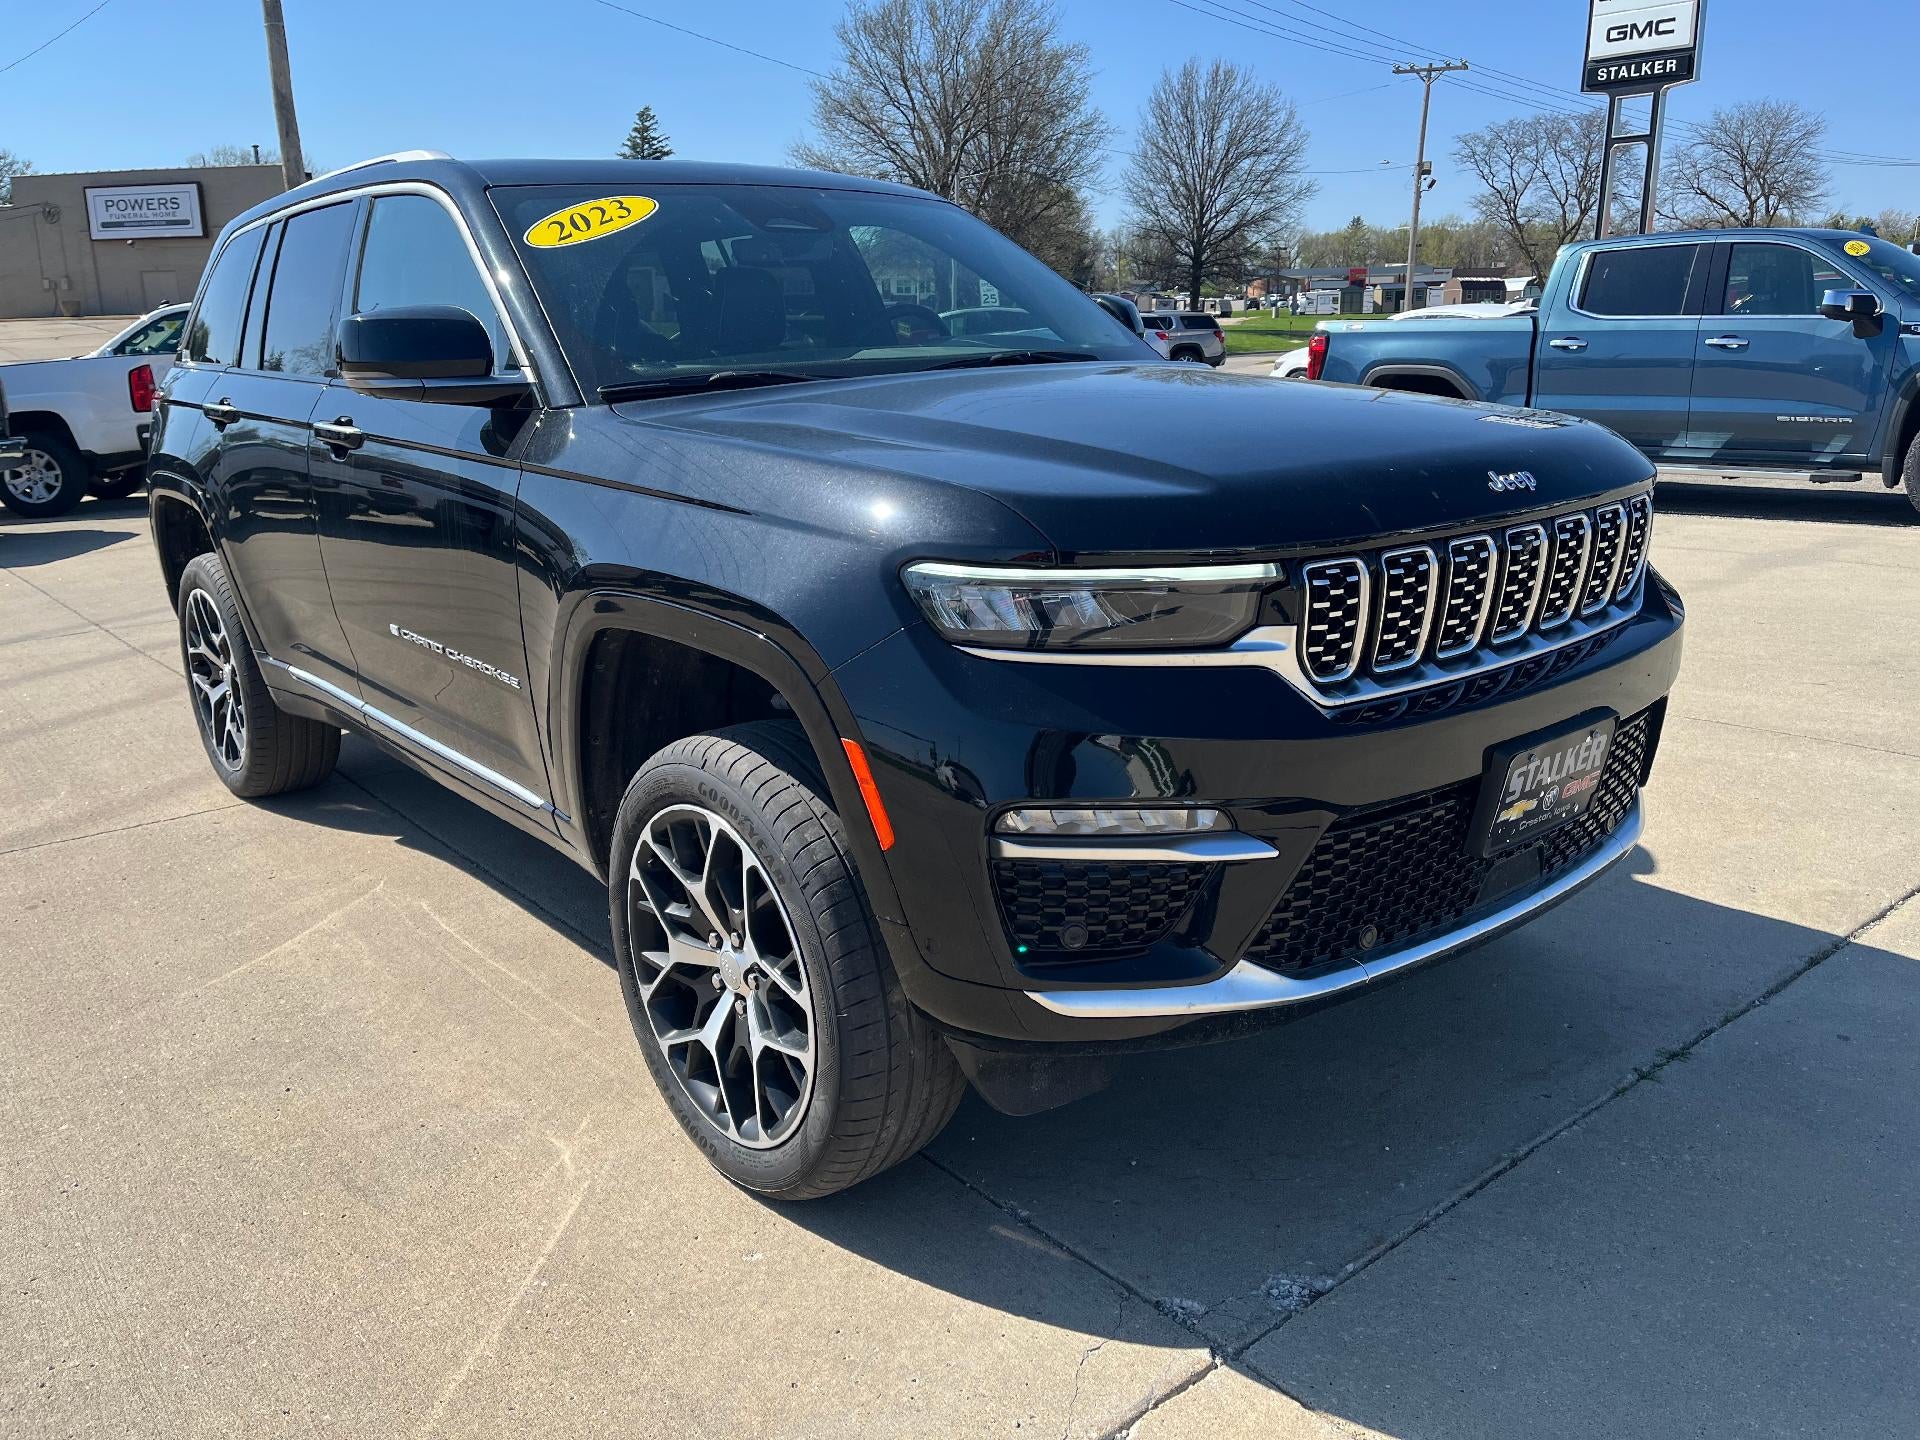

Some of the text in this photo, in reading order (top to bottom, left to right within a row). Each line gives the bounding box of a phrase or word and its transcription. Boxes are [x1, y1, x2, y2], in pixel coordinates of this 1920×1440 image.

[1606, 17, 1676, 42] GMC
[1597, 59, 1677, 80] STALKER
[104, 197, 180, 213] POWERS
[109, 212, 149, 220] FUNERAL
[547, 199, 632, 242] 2023
[982, 293, 998, 305] 25
[1776, 415, 1853, 423] SIERRA
[1487, 470, 1537, 492] Jeep
[445, 648, 522, 690] CHEROKEE
[1505, 734, 1608, 804] STALKER
[1561, 770, 1601, 799] GMC
[698, 782, 786, 885] GOODYEAR
